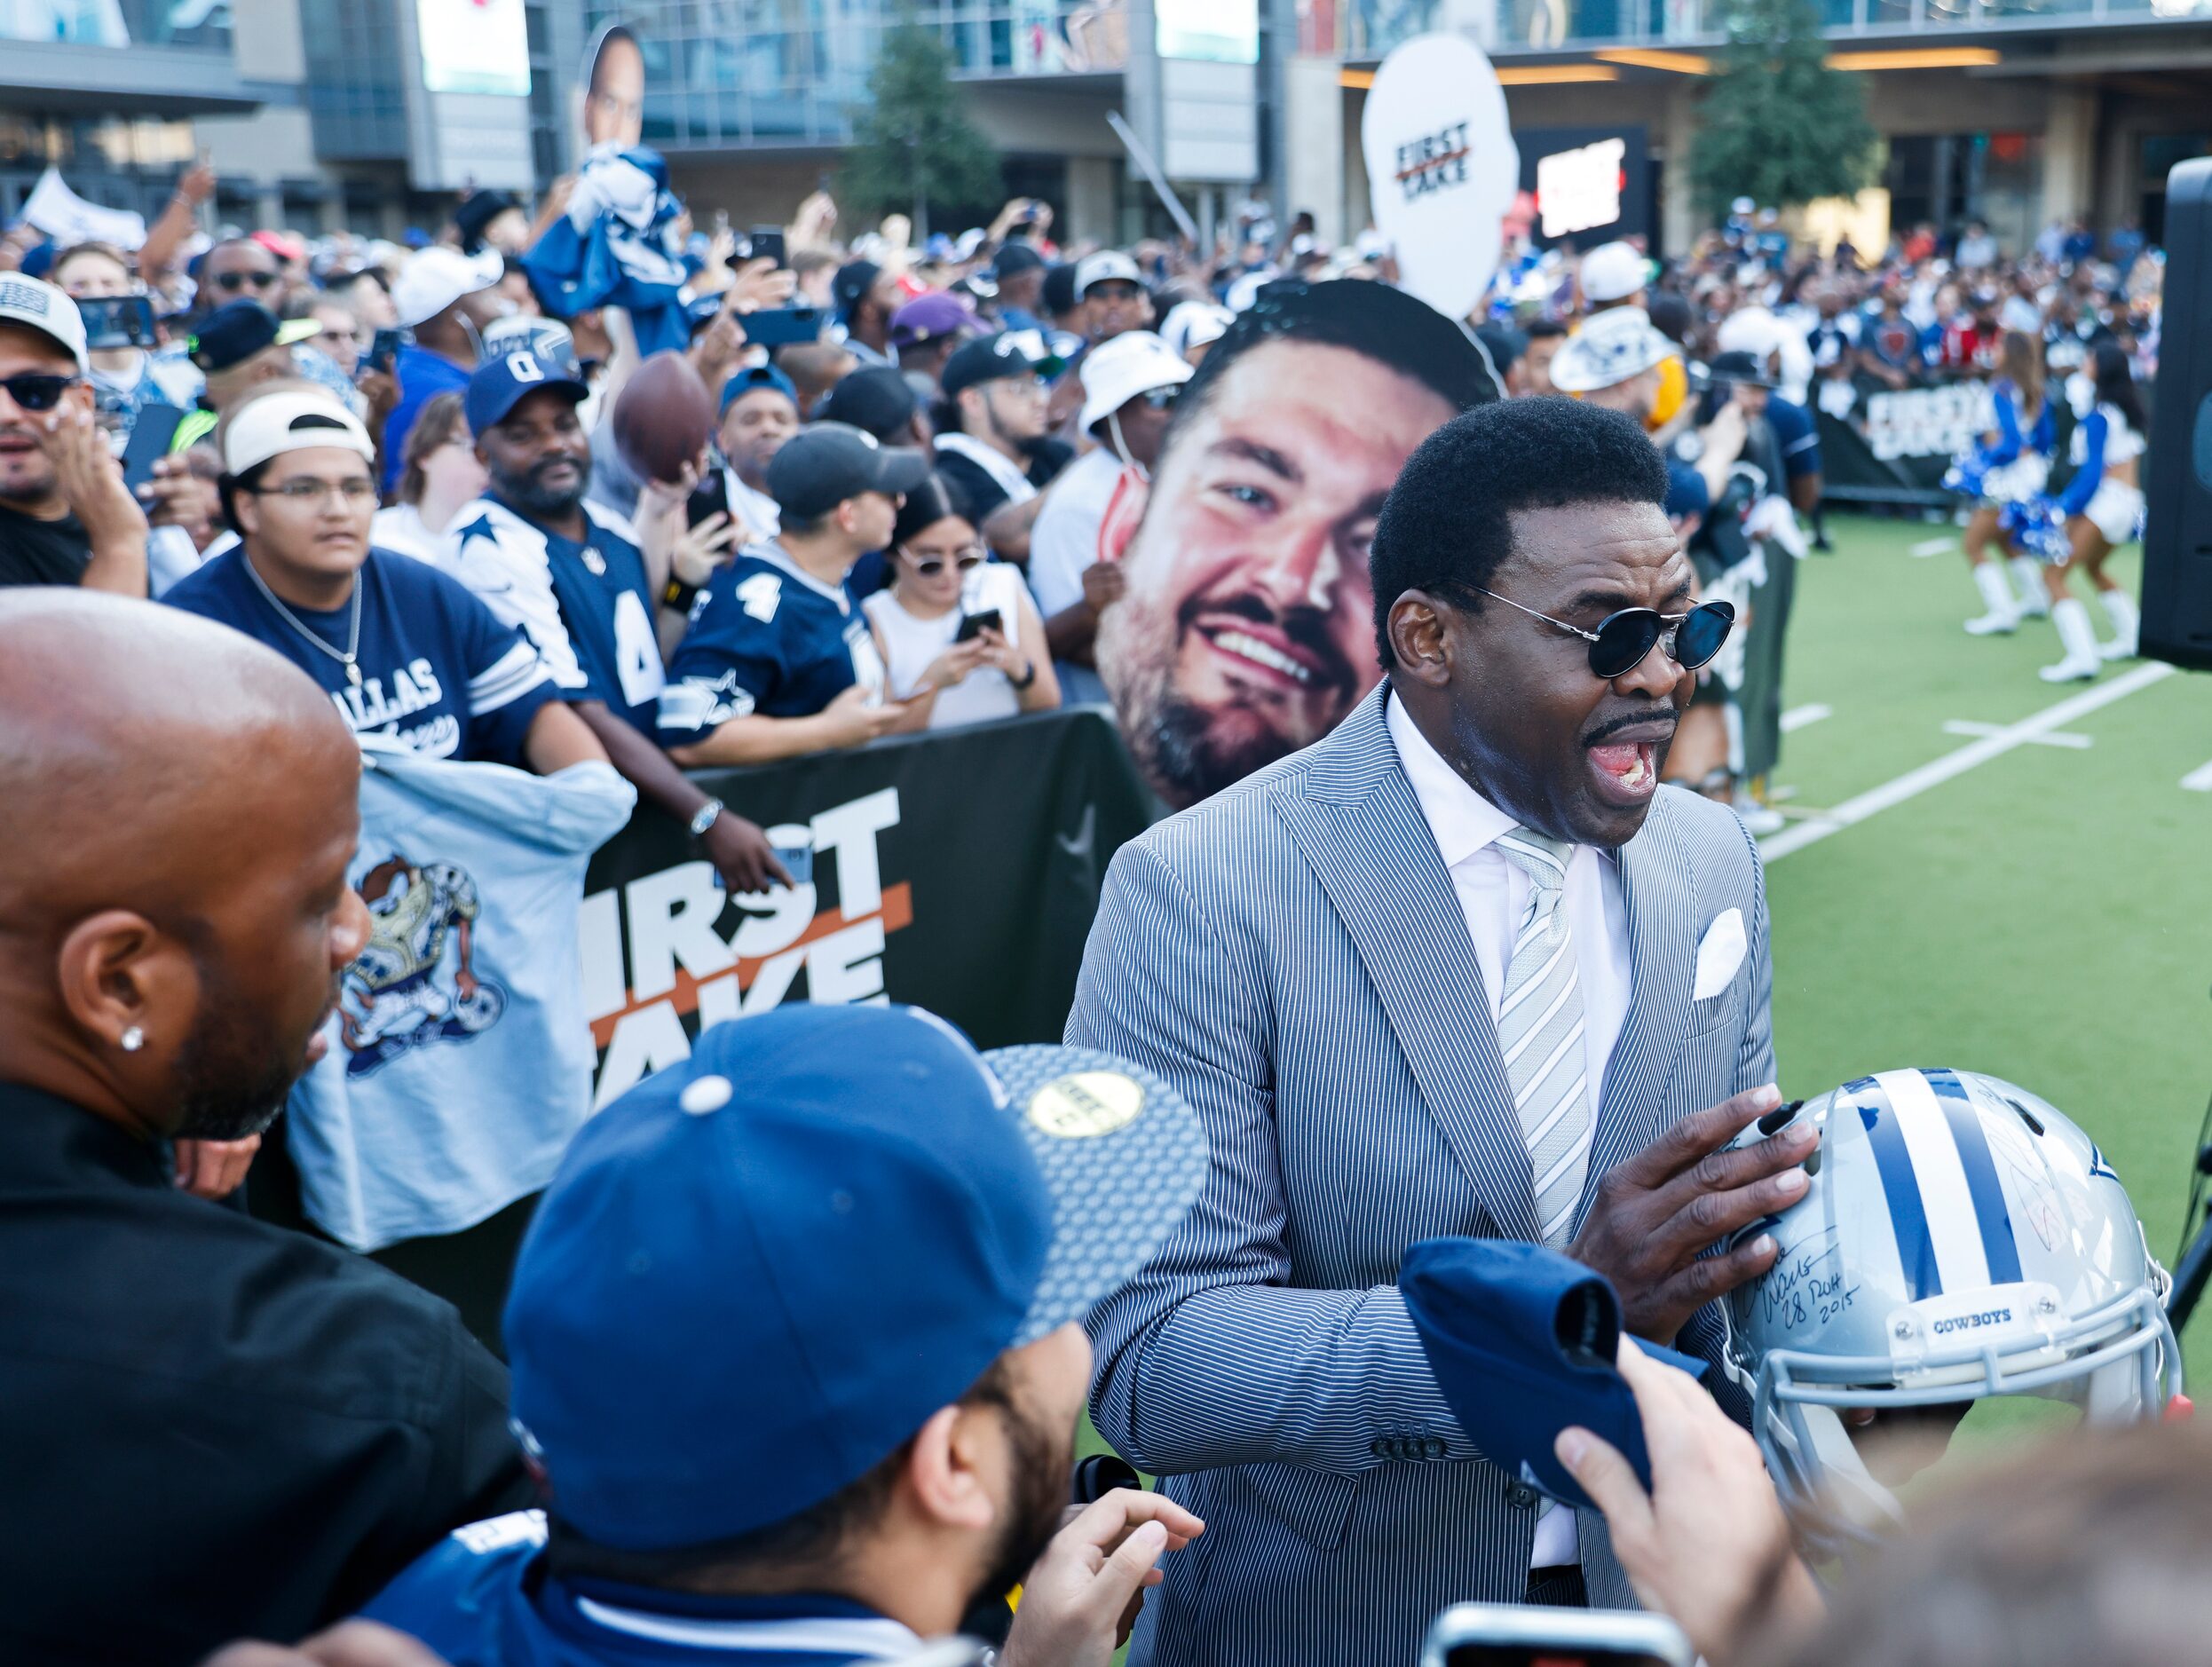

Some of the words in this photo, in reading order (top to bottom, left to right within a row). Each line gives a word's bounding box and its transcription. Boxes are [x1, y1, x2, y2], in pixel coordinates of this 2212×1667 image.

[1397, 122, 1468, 176] FIRST
[1402, 156, 1466, 201] TAKE
[613, 589, 665, 707] 4
[330, 657, 443, 732] ALLAS
[580, 786, 900, 1023] IRST
[1820, 1284, 1860, 1324] 2015
[1933, 1308, 2011, 1334] COWBOYS
